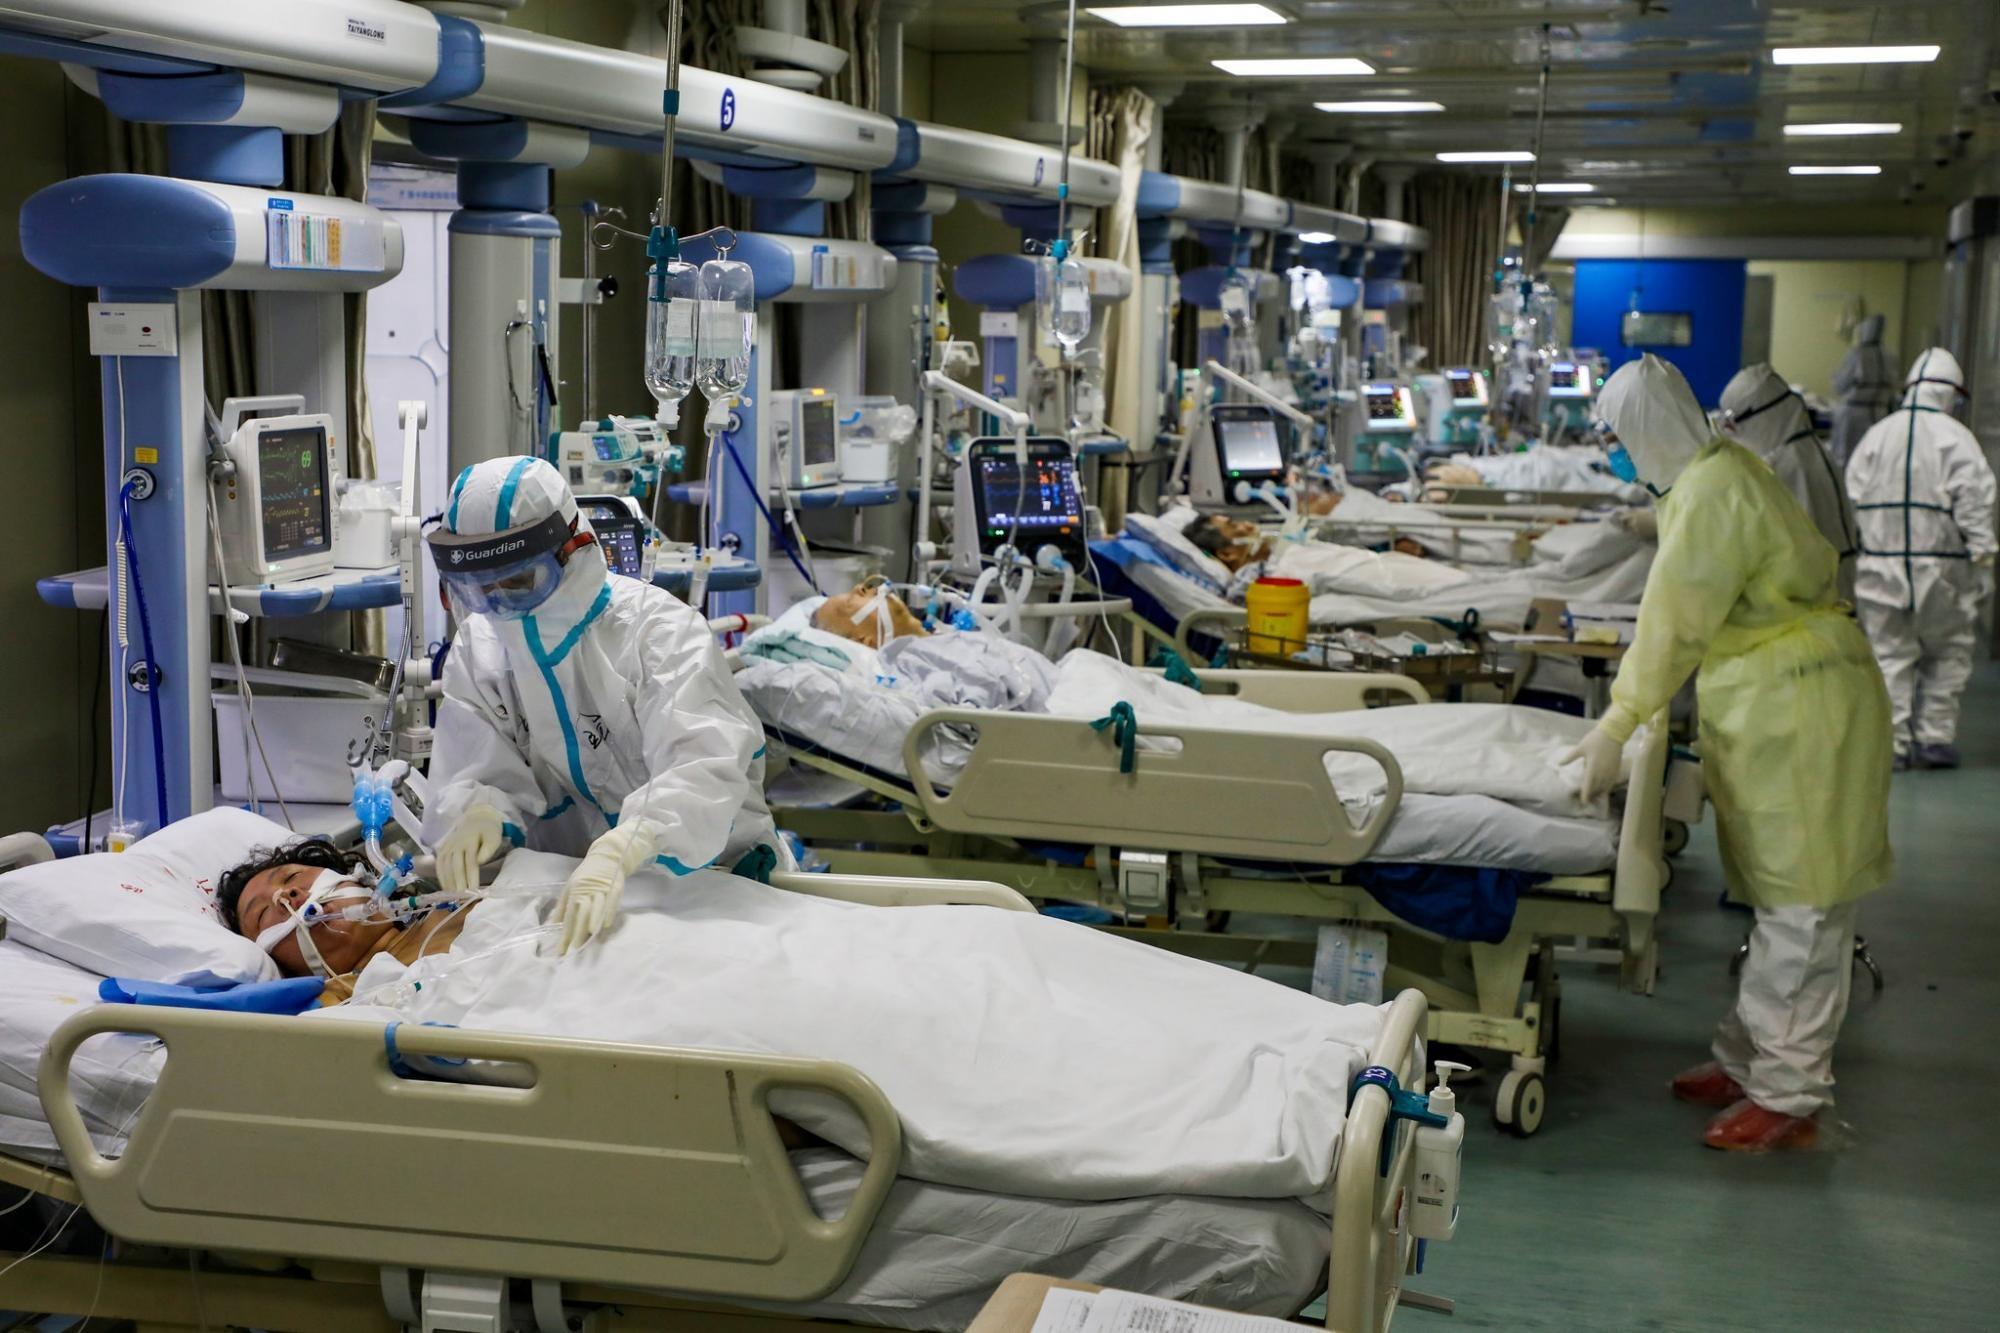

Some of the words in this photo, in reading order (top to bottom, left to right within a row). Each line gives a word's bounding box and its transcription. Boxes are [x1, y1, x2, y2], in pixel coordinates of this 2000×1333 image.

[723, 95, 733, 125] 5
[465, 540, 525, 560] Guardian
[1364, 1068, 1387, 1079] 13
